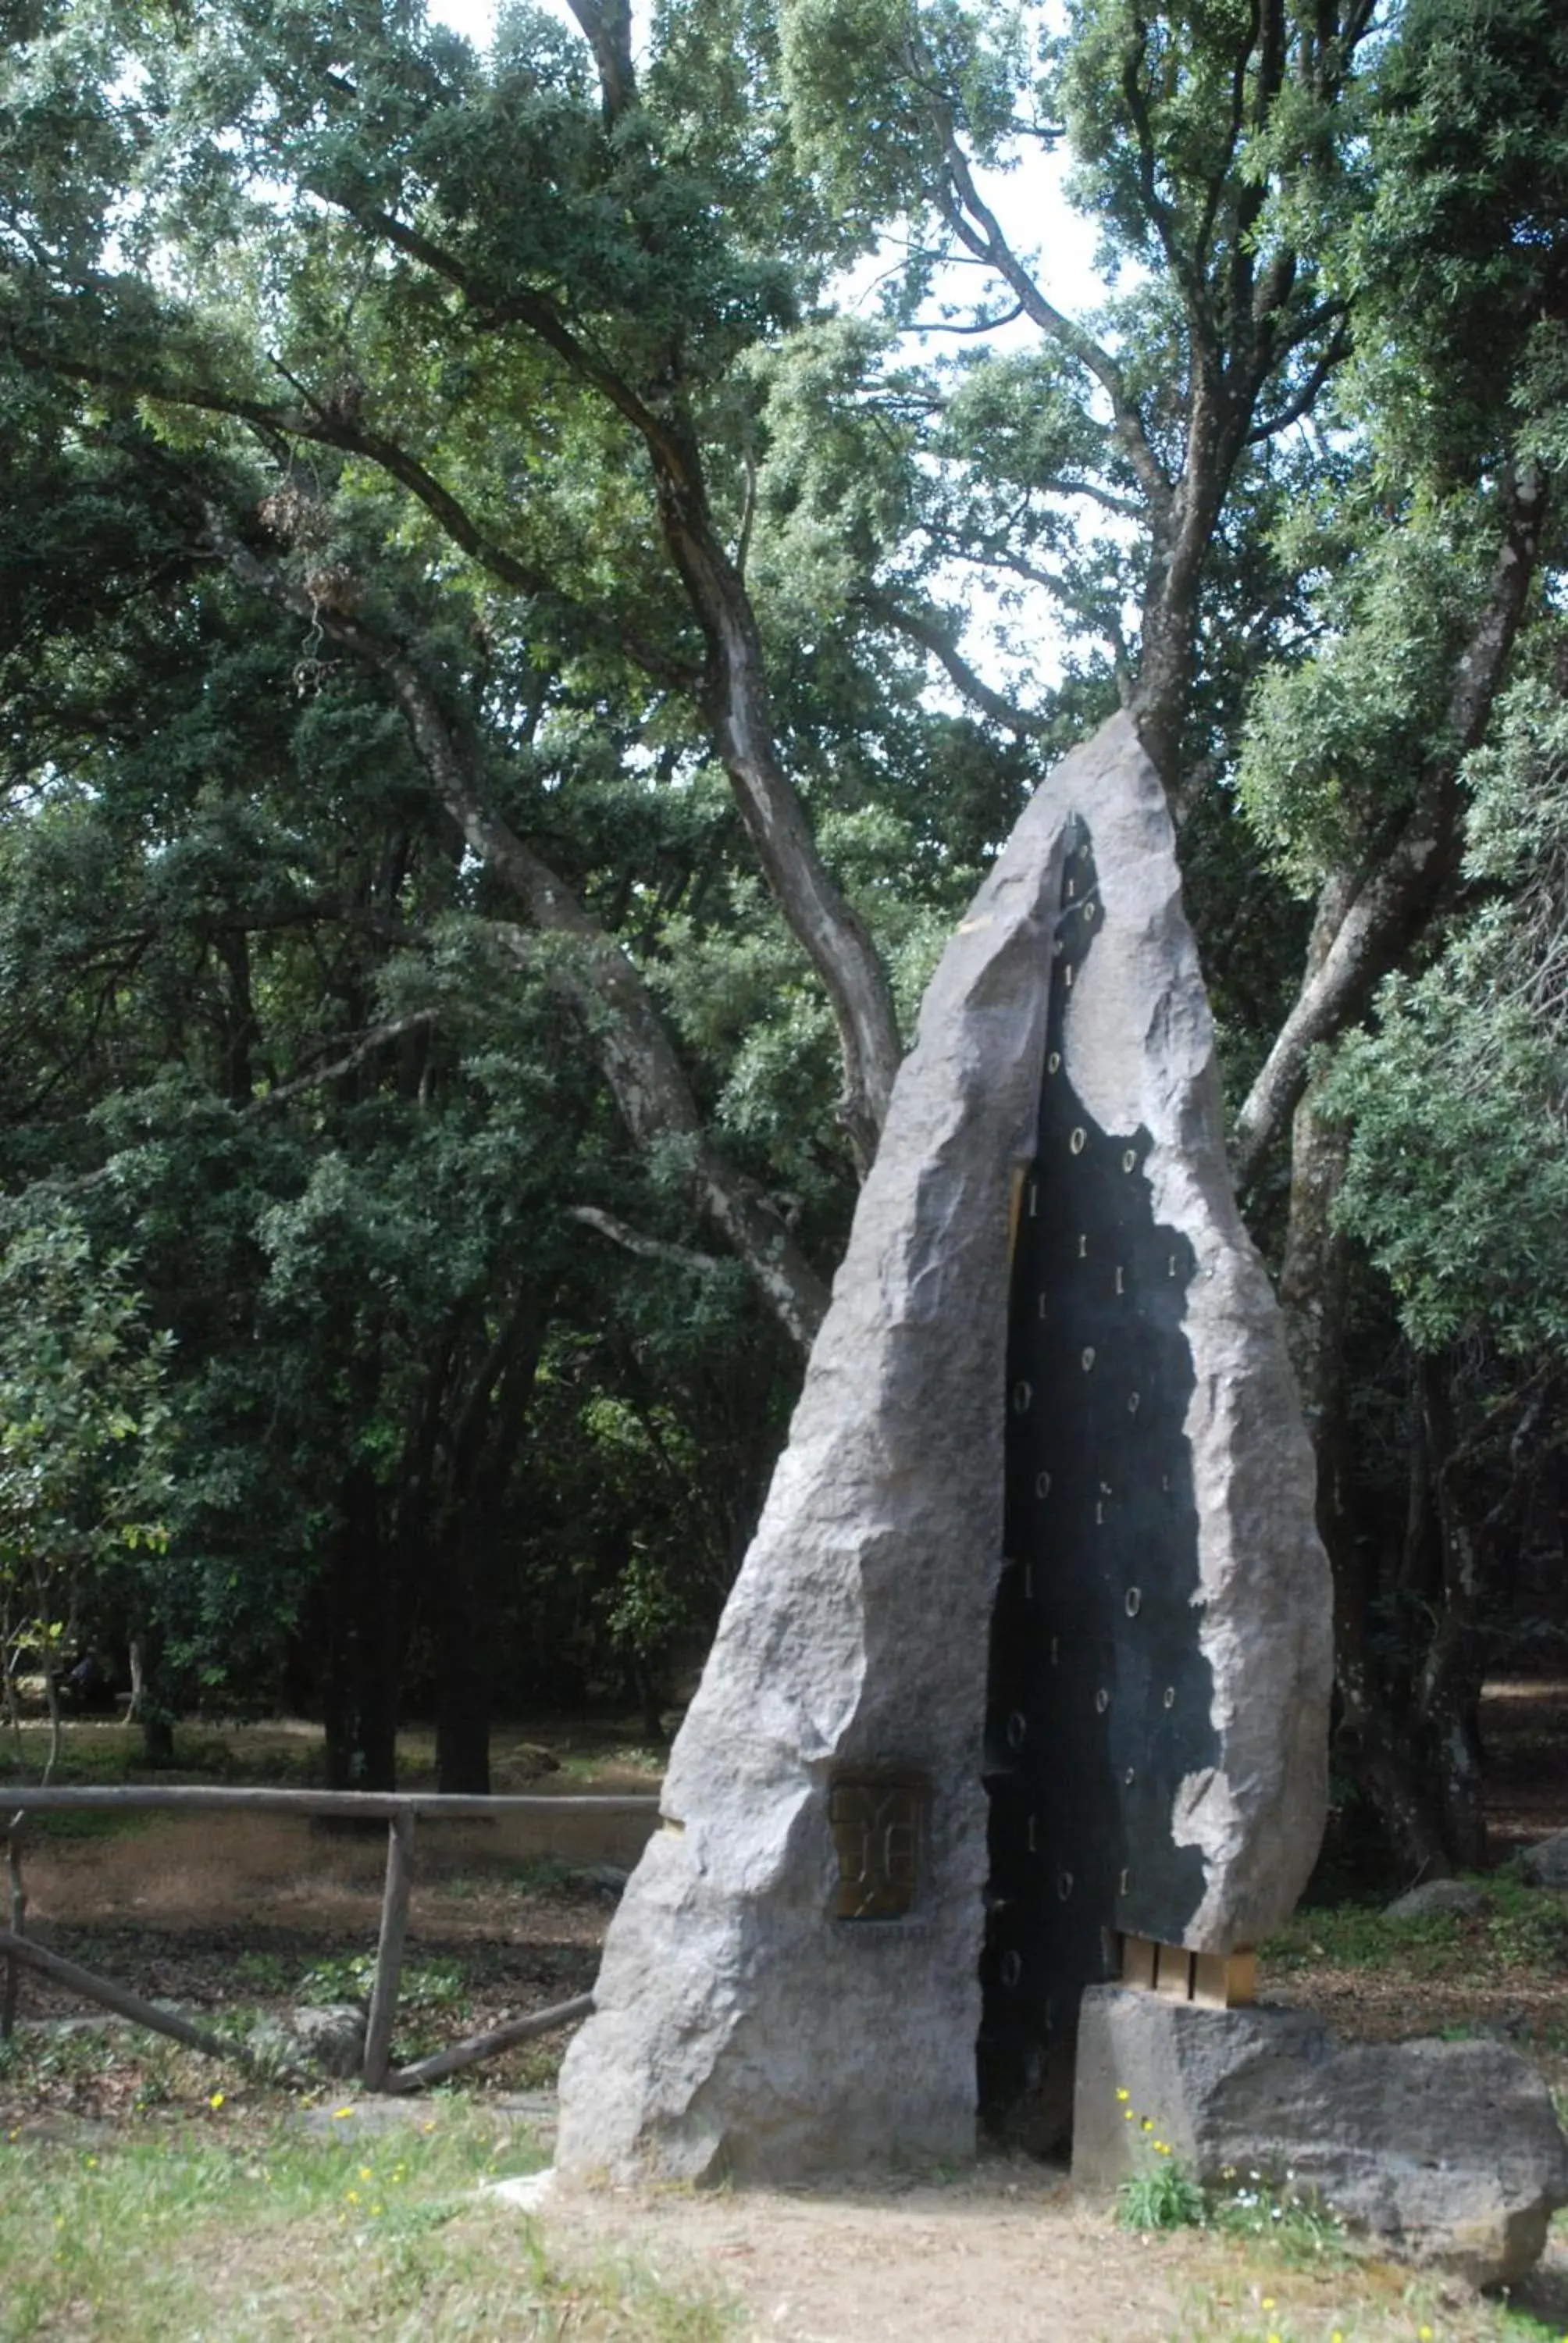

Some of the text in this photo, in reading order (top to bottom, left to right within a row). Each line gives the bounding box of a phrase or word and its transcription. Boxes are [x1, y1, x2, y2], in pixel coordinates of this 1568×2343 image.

[1084, 902, 1095, 922] 0
[1047, 1051, 1060, 1075] 0
[1070, 1127, 1086, 1155] 0
[1123, 1149, 1136, 1174] 0
[1081, 1346, 1096, 1373] 0
[1014, 1380, 1033, 1415] 0
[1127, 1390, 1139, 1413] 0
[1035, 1470, 1052, 1500] 0
[1124, 1586, 1141, 1617] 0
[1096, 1688, 1108, 1714] 0
[1164, 1685, 1174, 1709] 0
[1007, 1709, 1026, 1749] 0
[1124, 1766, 1135, 1785] 0
[1057, 1871, 1074, 1902] 0
[1001, 1949, 1022, 1988] 0
